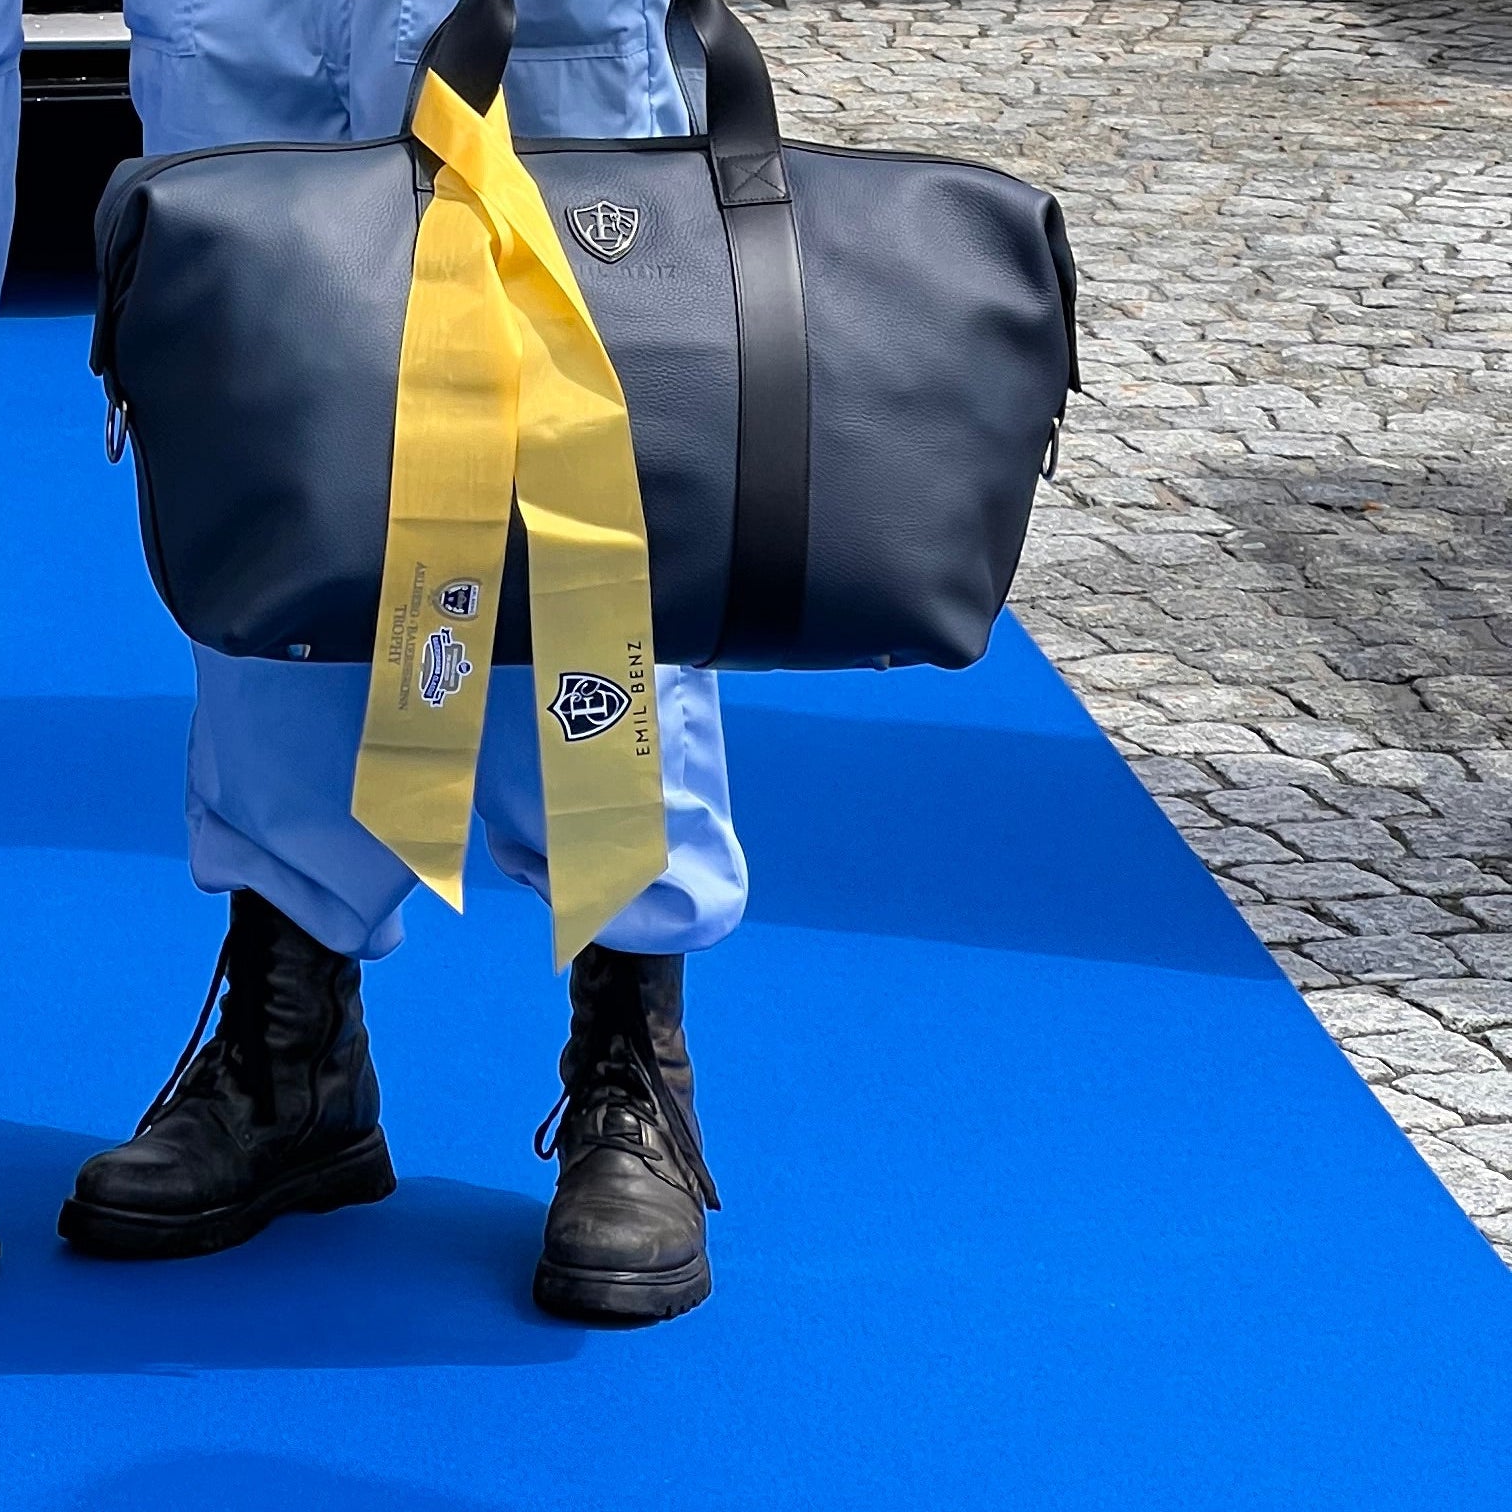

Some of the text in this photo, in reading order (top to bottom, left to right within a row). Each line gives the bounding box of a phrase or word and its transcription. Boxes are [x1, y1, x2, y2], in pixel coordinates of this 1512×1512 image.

[387, 604, 407, 665] TROPHY
[627, 641, 650, 757] EMIL BENZ
